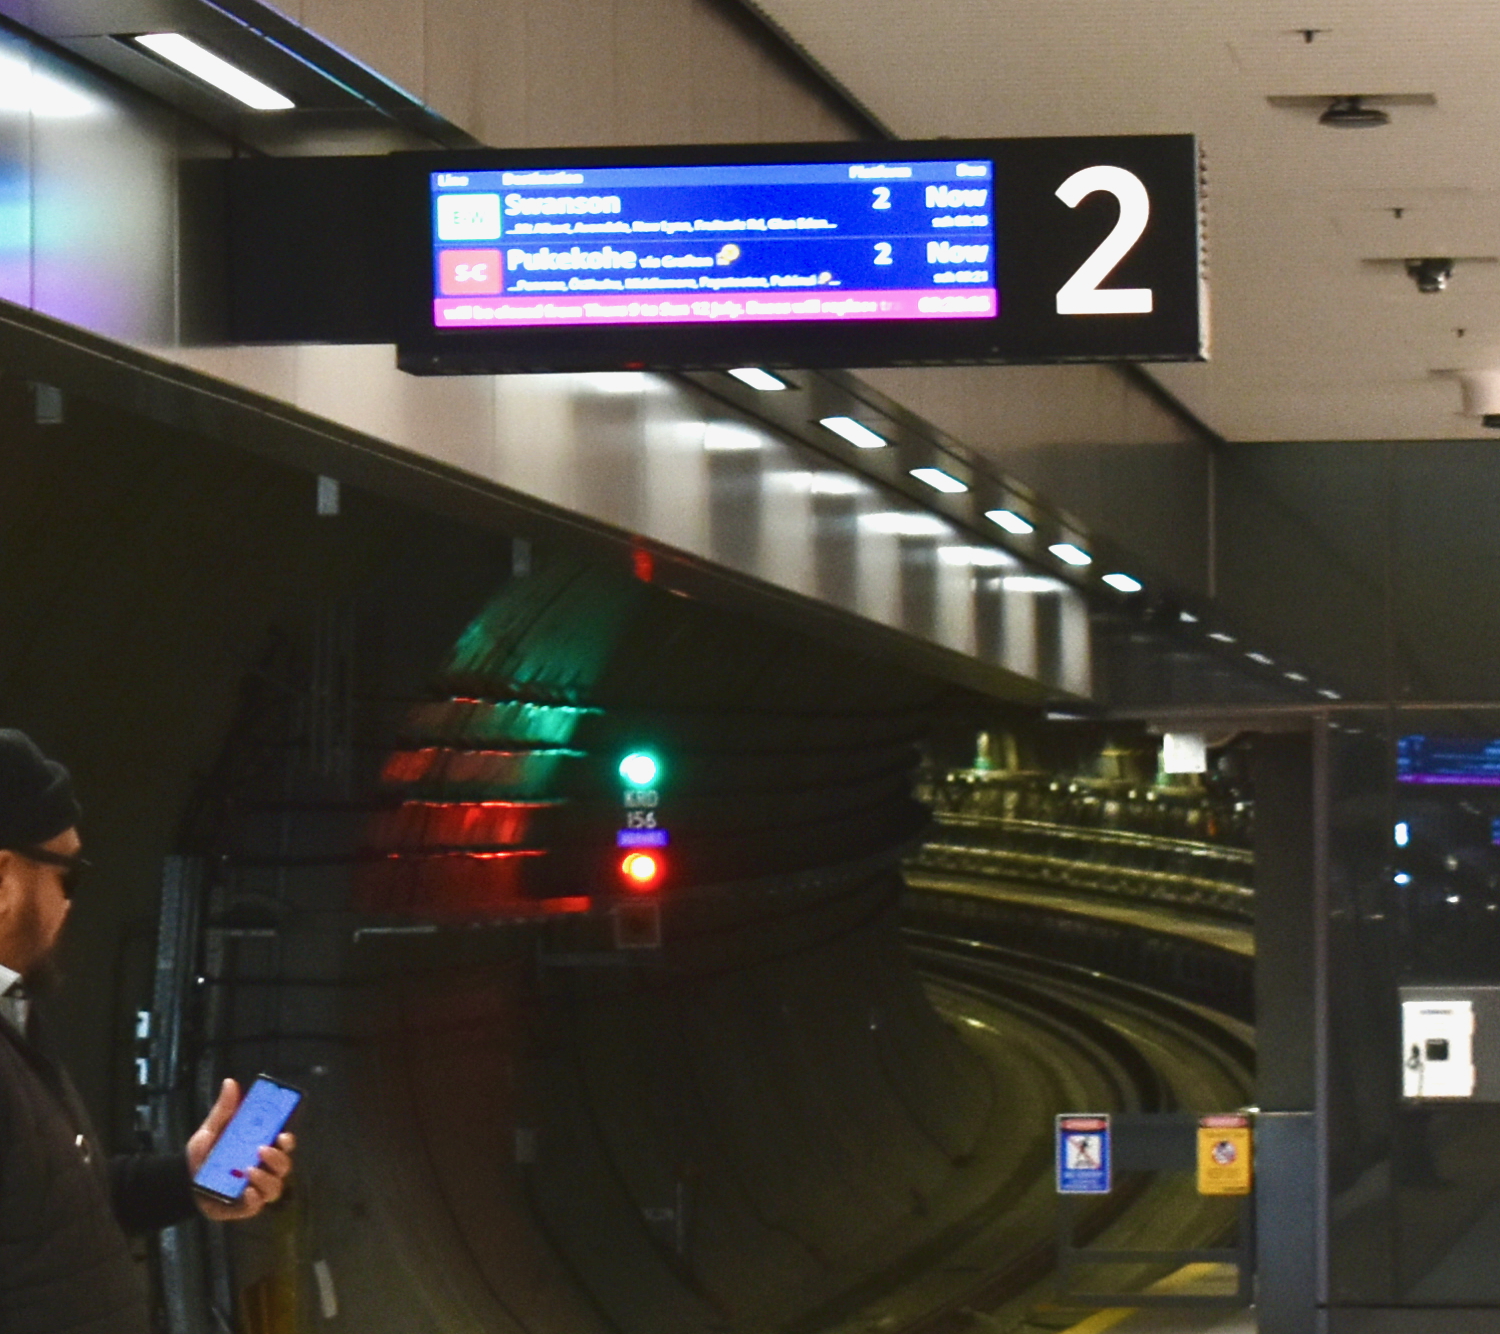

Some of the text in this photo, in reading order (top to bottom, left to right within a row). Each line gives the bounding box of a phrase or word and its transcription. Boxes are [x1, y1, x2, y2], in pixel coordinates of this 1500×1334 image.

[504, 185, 988, 216] Swanson 2 Now
[1054, 164, 1153, 315] 2
[507, 246, 637, 271] Pukekohe
[873, 242, 893, 265] 2
[927, 241, 989, 264] Now
[627, 811, 657, 828] 156
